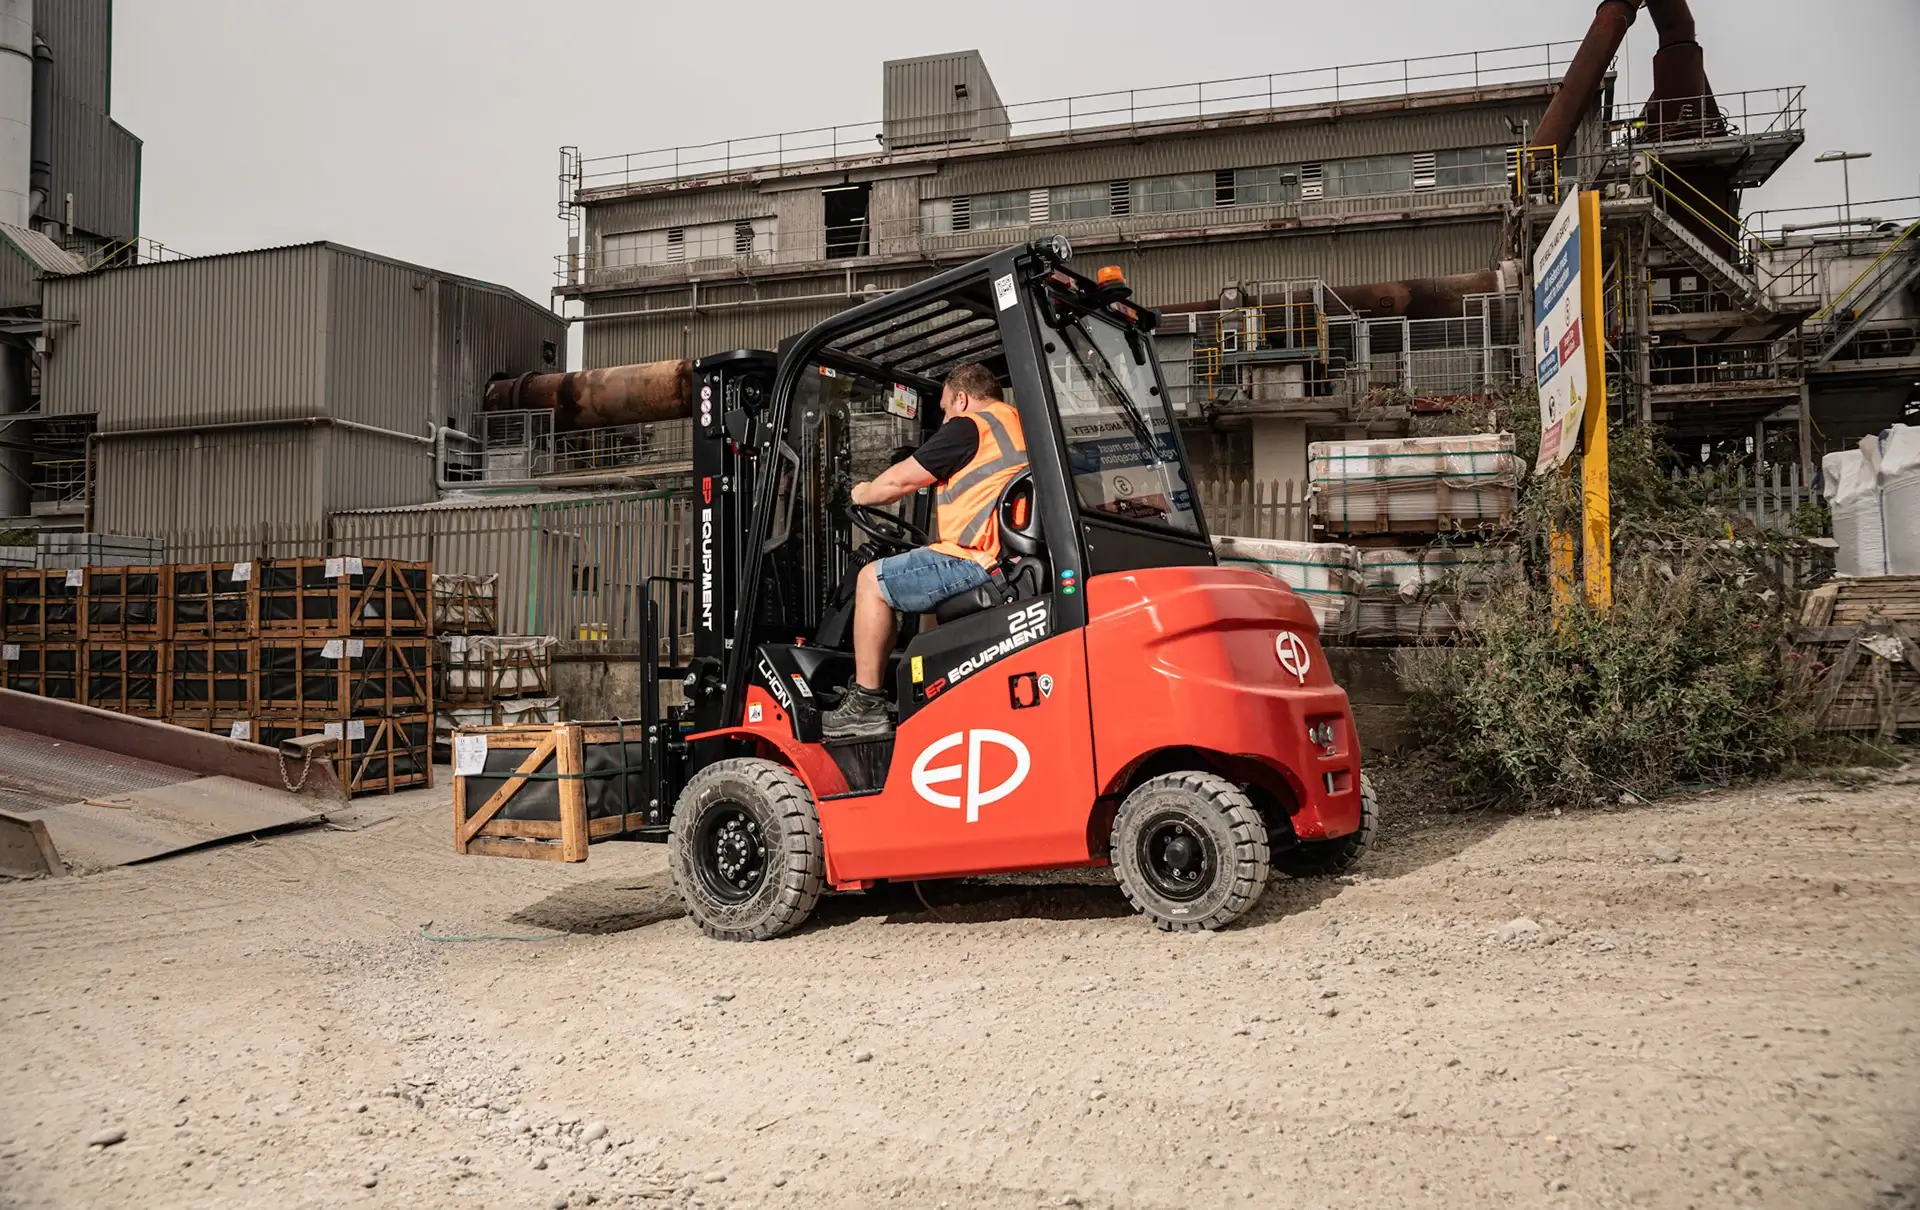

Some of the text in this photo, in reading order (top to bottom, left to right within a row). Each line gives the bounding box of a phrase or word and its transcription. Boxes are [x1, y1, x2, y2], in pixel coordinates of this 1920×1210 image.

[702, 476, 712, 631] EP EQUIPMENT
[1007, 601, 1047, 635] 25
[924, 677, 946, 699] EP
[947, 622, 1046, 684] EQUIPMENT
[1275, 631, 1310, 684] EP
[911, 728, 1031, 823] EP
